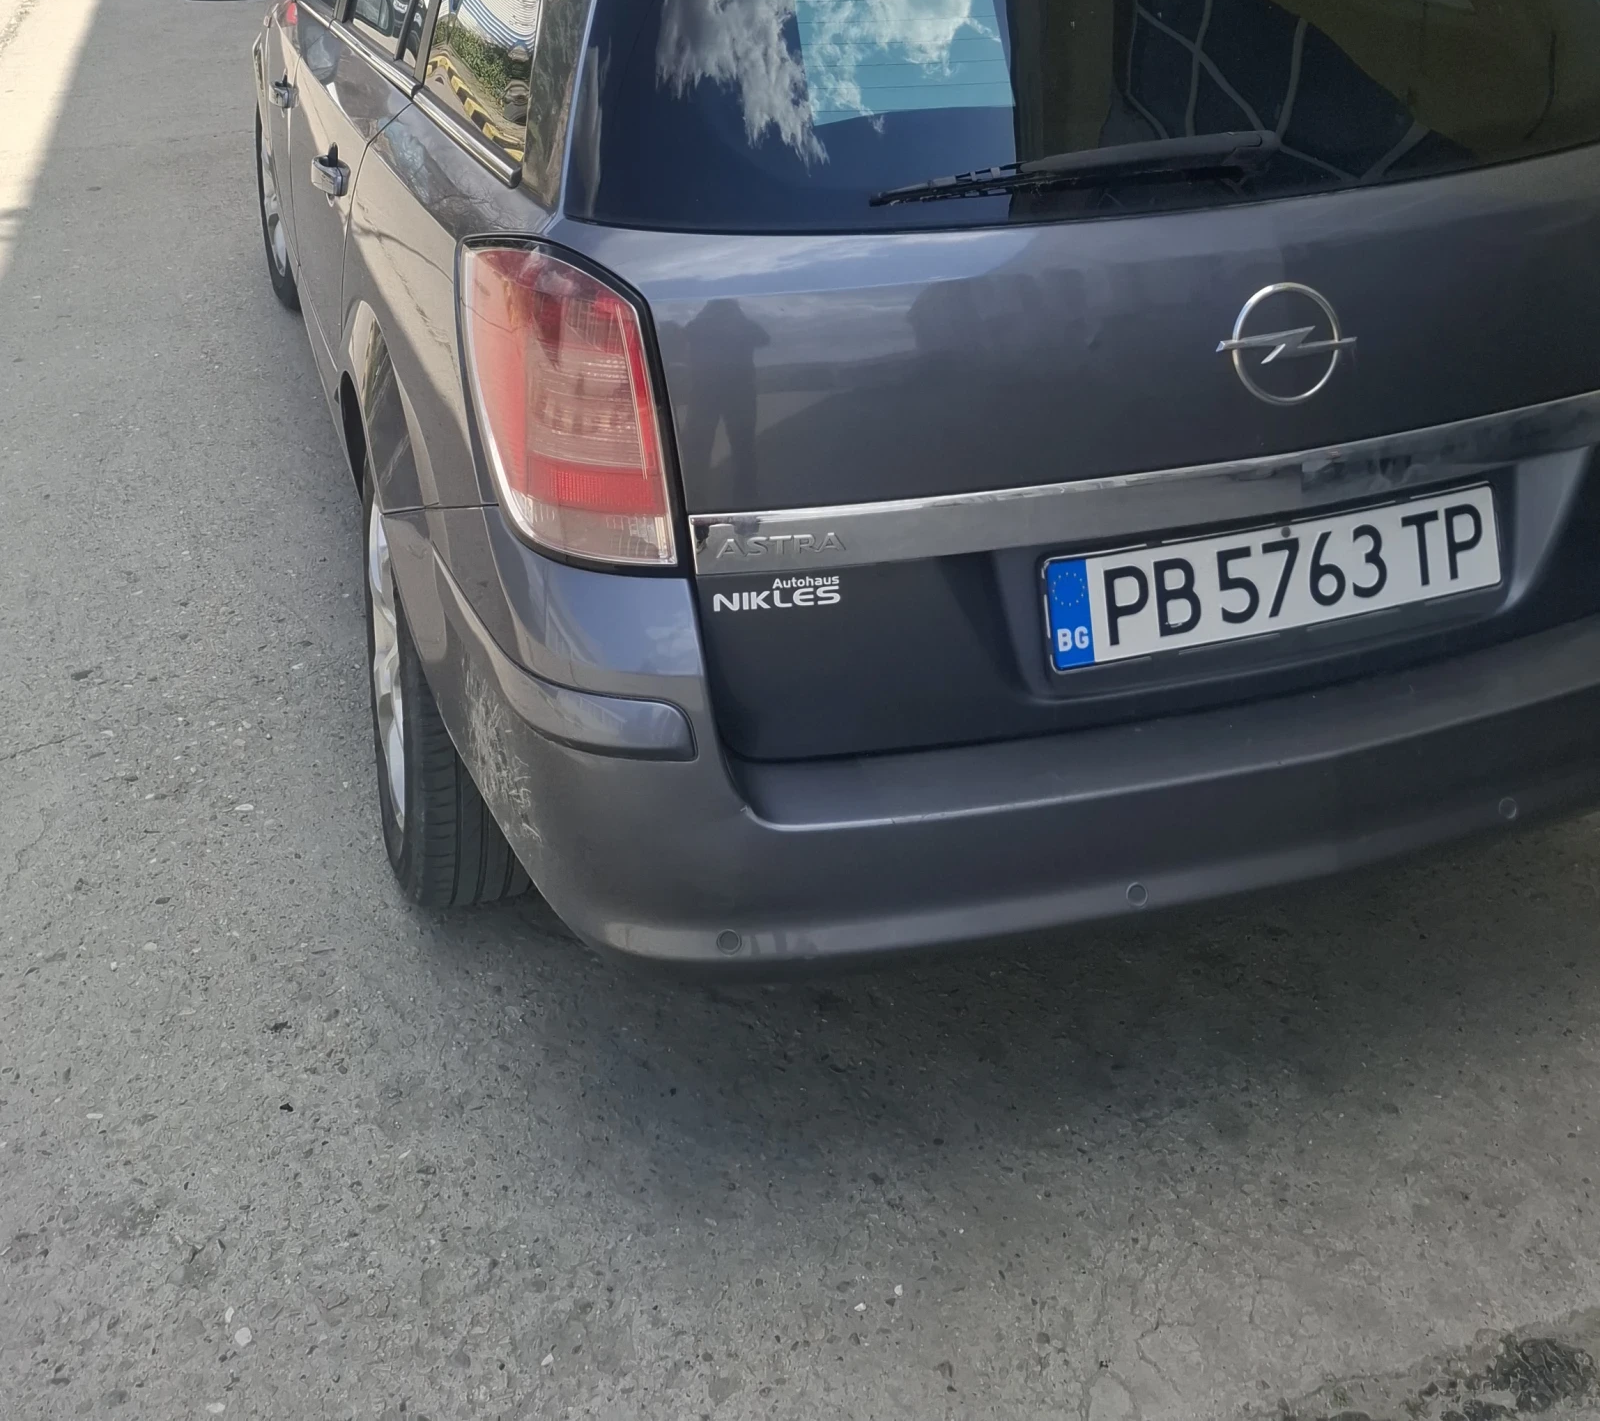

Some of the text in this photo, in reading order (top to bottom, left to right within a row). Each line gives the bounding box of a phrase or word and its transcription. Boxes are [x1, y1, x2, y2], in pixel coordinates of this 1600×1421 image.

[715, 532, 847, 559] ASTRA
[772, 576, 840, 589] Autohaus
[1102, 503, 1484, 647] PB 5763 TP
[713, 585, 841, 612] NIKLES
[1056, 625, 1090, 653] BG
